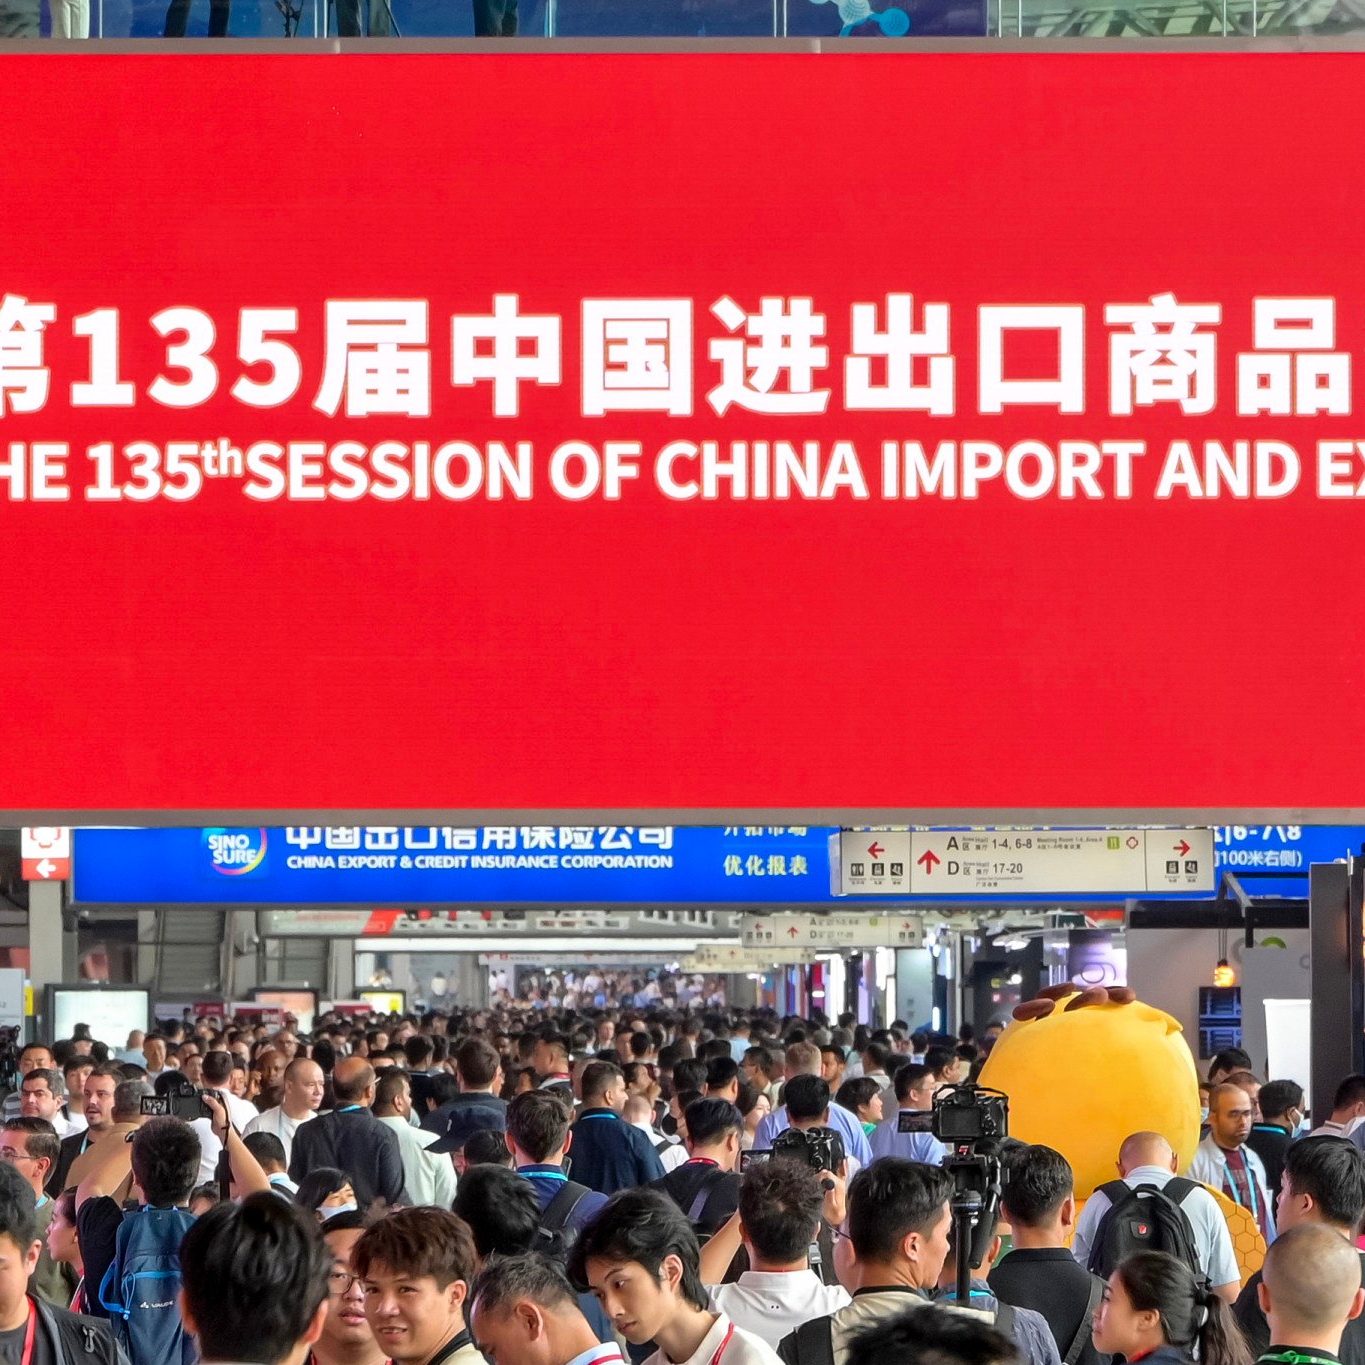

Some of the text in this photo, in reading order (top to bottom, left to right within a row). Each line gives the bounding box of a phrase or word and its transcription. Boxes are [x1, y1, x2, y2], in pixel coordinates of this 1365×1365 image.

[549, 441, 642, 500] OF
[655, 441, 869, 500] CHINA
[882, 440, 1146, 499] IMPORT
[1155, 441, 1300, 498] AND
[208, 834, 250, 850] SINO
[946, 836, 959, 850] A
[1015, 838, 1032, 849] 6-8
[213, 849, 257, 864] SURE
[287, 855, 673, 869] CHINA EXPORT & CREDIT INSURANCE CORPORATION
[723, 855, 808, 876] 优化报表
[948, 861, 960, 875] D
[993, 863, 1023, 874] 17-20
